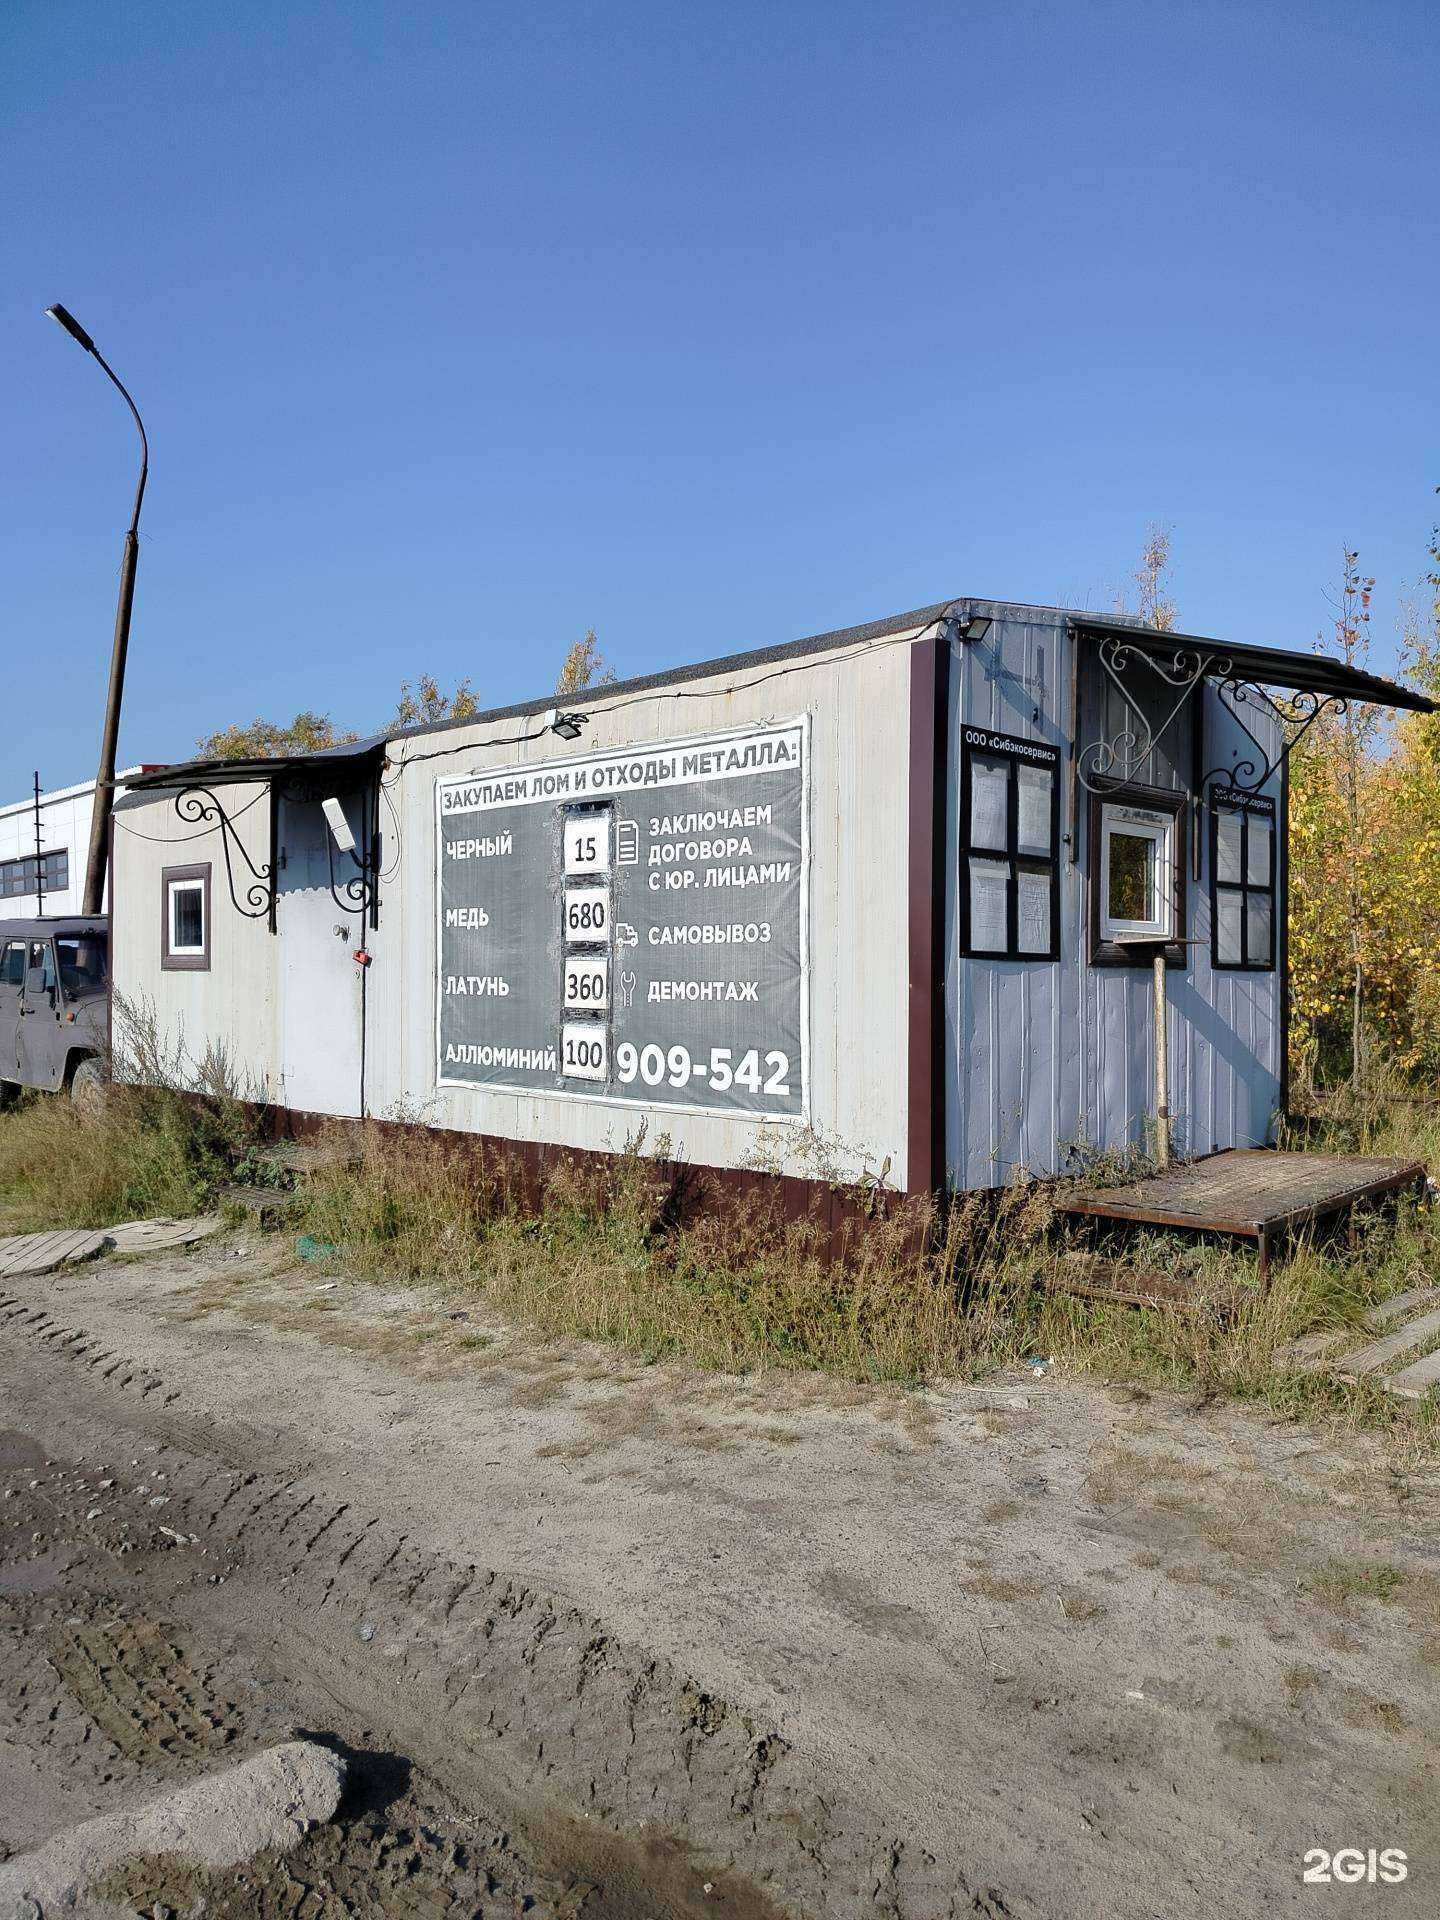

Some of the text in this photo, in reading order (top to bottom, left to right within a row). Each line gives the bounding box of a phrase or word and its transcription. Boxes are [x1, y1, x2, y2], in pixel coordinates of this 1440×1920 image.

[965, 731, 1056, 761] ООО «Сибэкосервис»
[444, 740, 798, 810] ЗАКУПАЕМ ЛОМ И ОТХОДЫ МЕТАЛЛА:
[648, 804, 773, 837] ЗАКЛЮЧАЕМ
[446, 830, 513, 860] ЧЕРНЫЙ
[575, 837, 597, 862] 15
[647, 837, 753, 867] ДОГОВОРА
[648, 862, 791, 891] С ЮР. ЛИЦАМИ
[445, 907, 490, 930] МЕДЬ
[568, 902, 605, 930] 680
[648, 922, 772, 945] САМОВЫВОЗ
[445, 976, 510, 997] ЛАТУНЬ
[567, 973, 604, 1001] 360
[647, 981, 759, 1003] ДЕМОНТАЖ
[445, 1043, 557, 1072] АЛЛЮМИНИЙ
[566, 1040, 603, 1069] 100
[616, 1042, 790, 1096] 909-542
